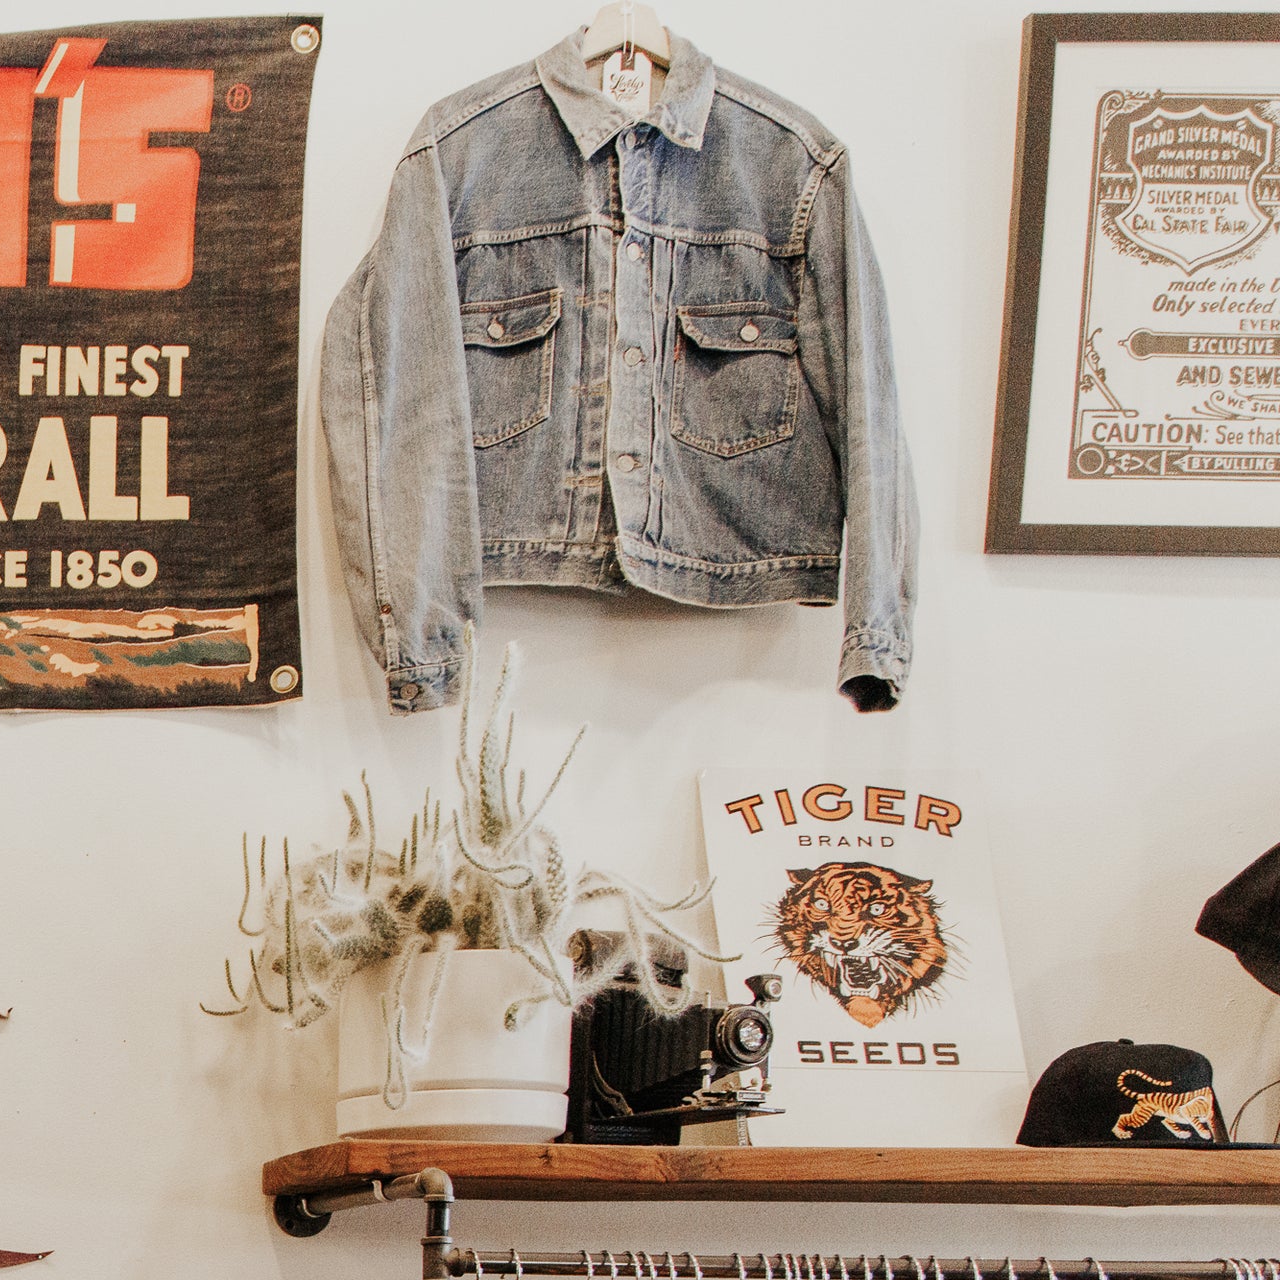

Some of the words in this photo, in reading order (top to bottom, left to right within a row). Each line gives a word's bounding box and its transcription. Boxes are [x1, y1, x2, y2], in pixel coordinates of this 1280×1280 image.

[1134, 128, 1174, 154] GRAND
[1177, 126, 1219, 143] SILVER
[1223, 128, 1263, 157] MEDAL
[1157, 149, 1219, 161] AWARDED
[1220, 149, 1240, 161] BY
[1198, 164, 1251, 181] INSTITUTE
[1147, 189, 1194, 205] SILVER
[1196, 190, 1239, 205] MEDAL
[1153, 206, 1205, 214] AWARDED
[1208, 206, 1225, 214] BY
[1160, 214, 1209, 234] STATE
[1213, 215, 1248, 234] FAIR
[1166, 277, 1215, 293] made
[1219, 276, 1238, 293] in
[1239, 277, 1266, 293] the
[1152, 293, 1193, 317] Only
[1198, 296, 1274, 314] selected
[1188, 337, 1276, 355] EXCLUSIVE
[18, 343, 190, 397] FINEST
[1176, 365, 1221, 387] AND
[1227, 397, 1245, 410] WE
[1091, 422, 1209, 444] CAUTION:
[1214, 424, 1244, 446] See
[1191, 458, 1212, 471] BY
[1213, 457, 1275, 472] PULLING
[49, 549, 159, 588] 1850
[724, 781, 964, 839] TIGER
[797, 834, 896, 850] BRAND
[796, 1039, 961, 1066] SEEDS
